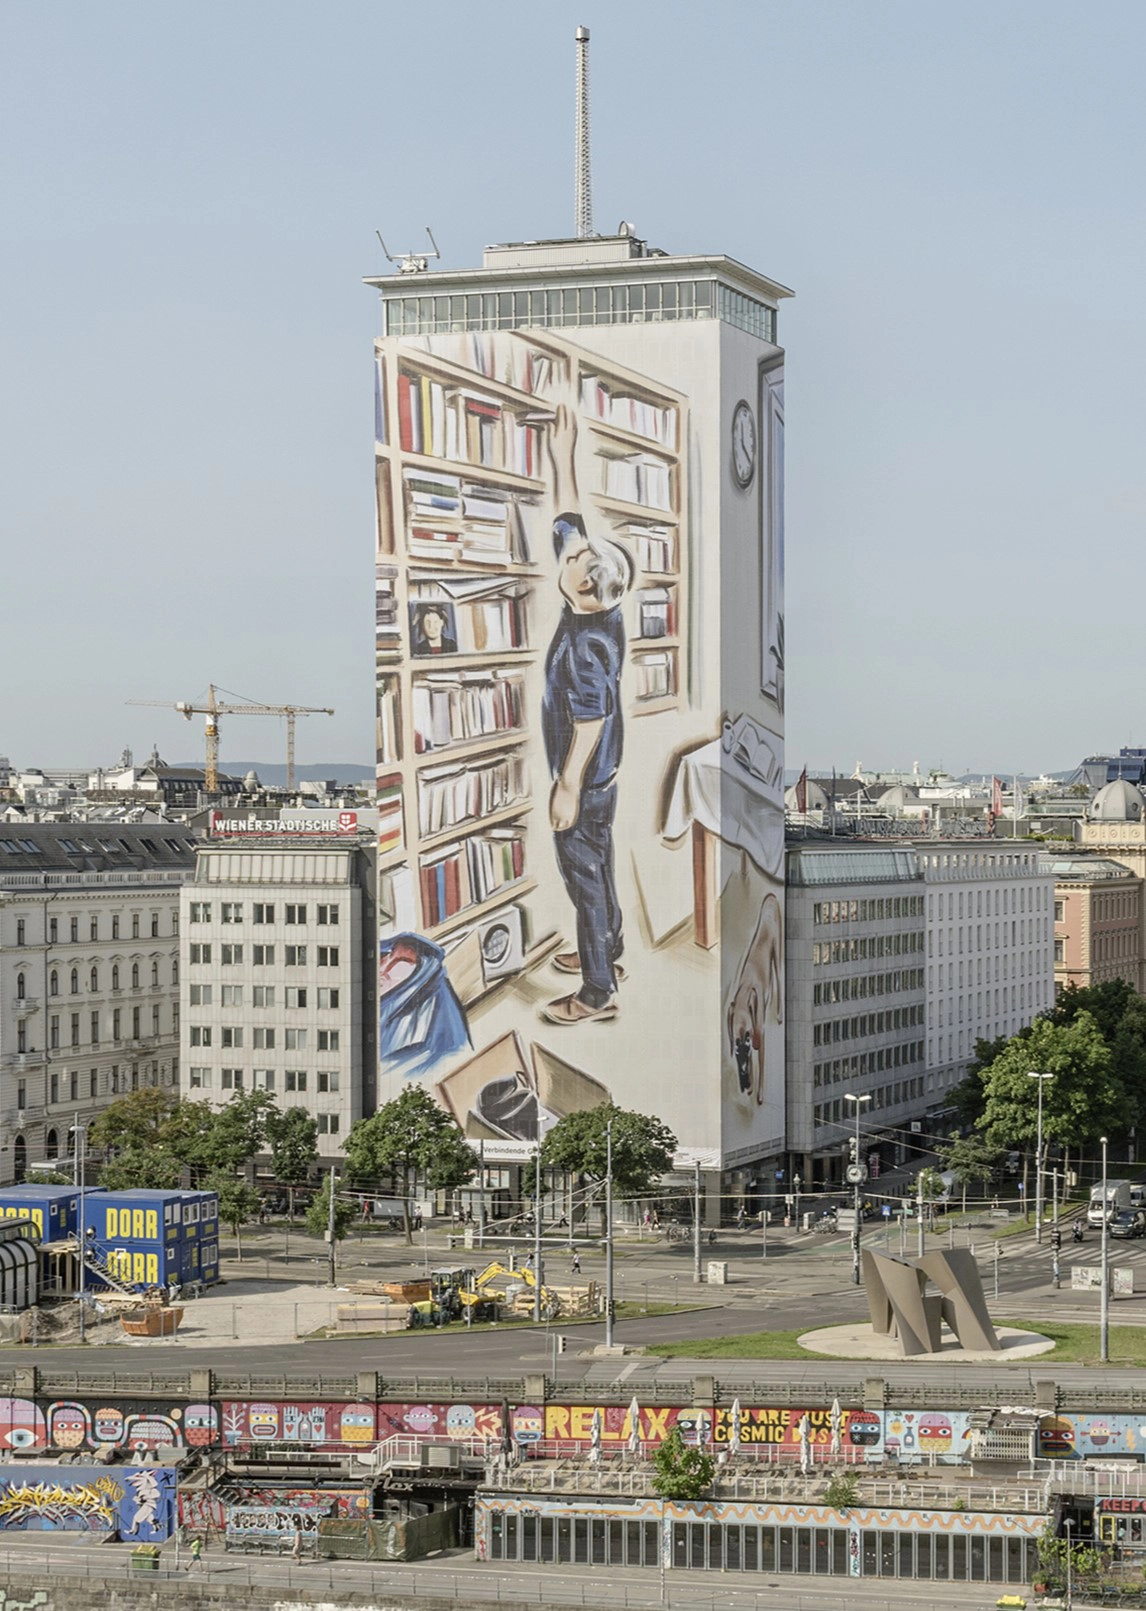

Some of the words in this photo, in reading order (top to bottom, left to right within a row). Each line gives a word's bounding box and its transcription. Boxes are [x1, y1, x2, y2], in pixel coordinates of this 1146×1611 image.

[215, 819, 263, 831] WIENER
[484, 1146, 526, 1155] Verbindende
[106, 1208, 158, 1240] PORR
[545, 1406, 671, 1440] RELAX
[756, 1409, 791, 1426] ARE
[714, 1425, 785, 1443] COSMIC
[1103, 1498, 1140, 1512] KEEP
